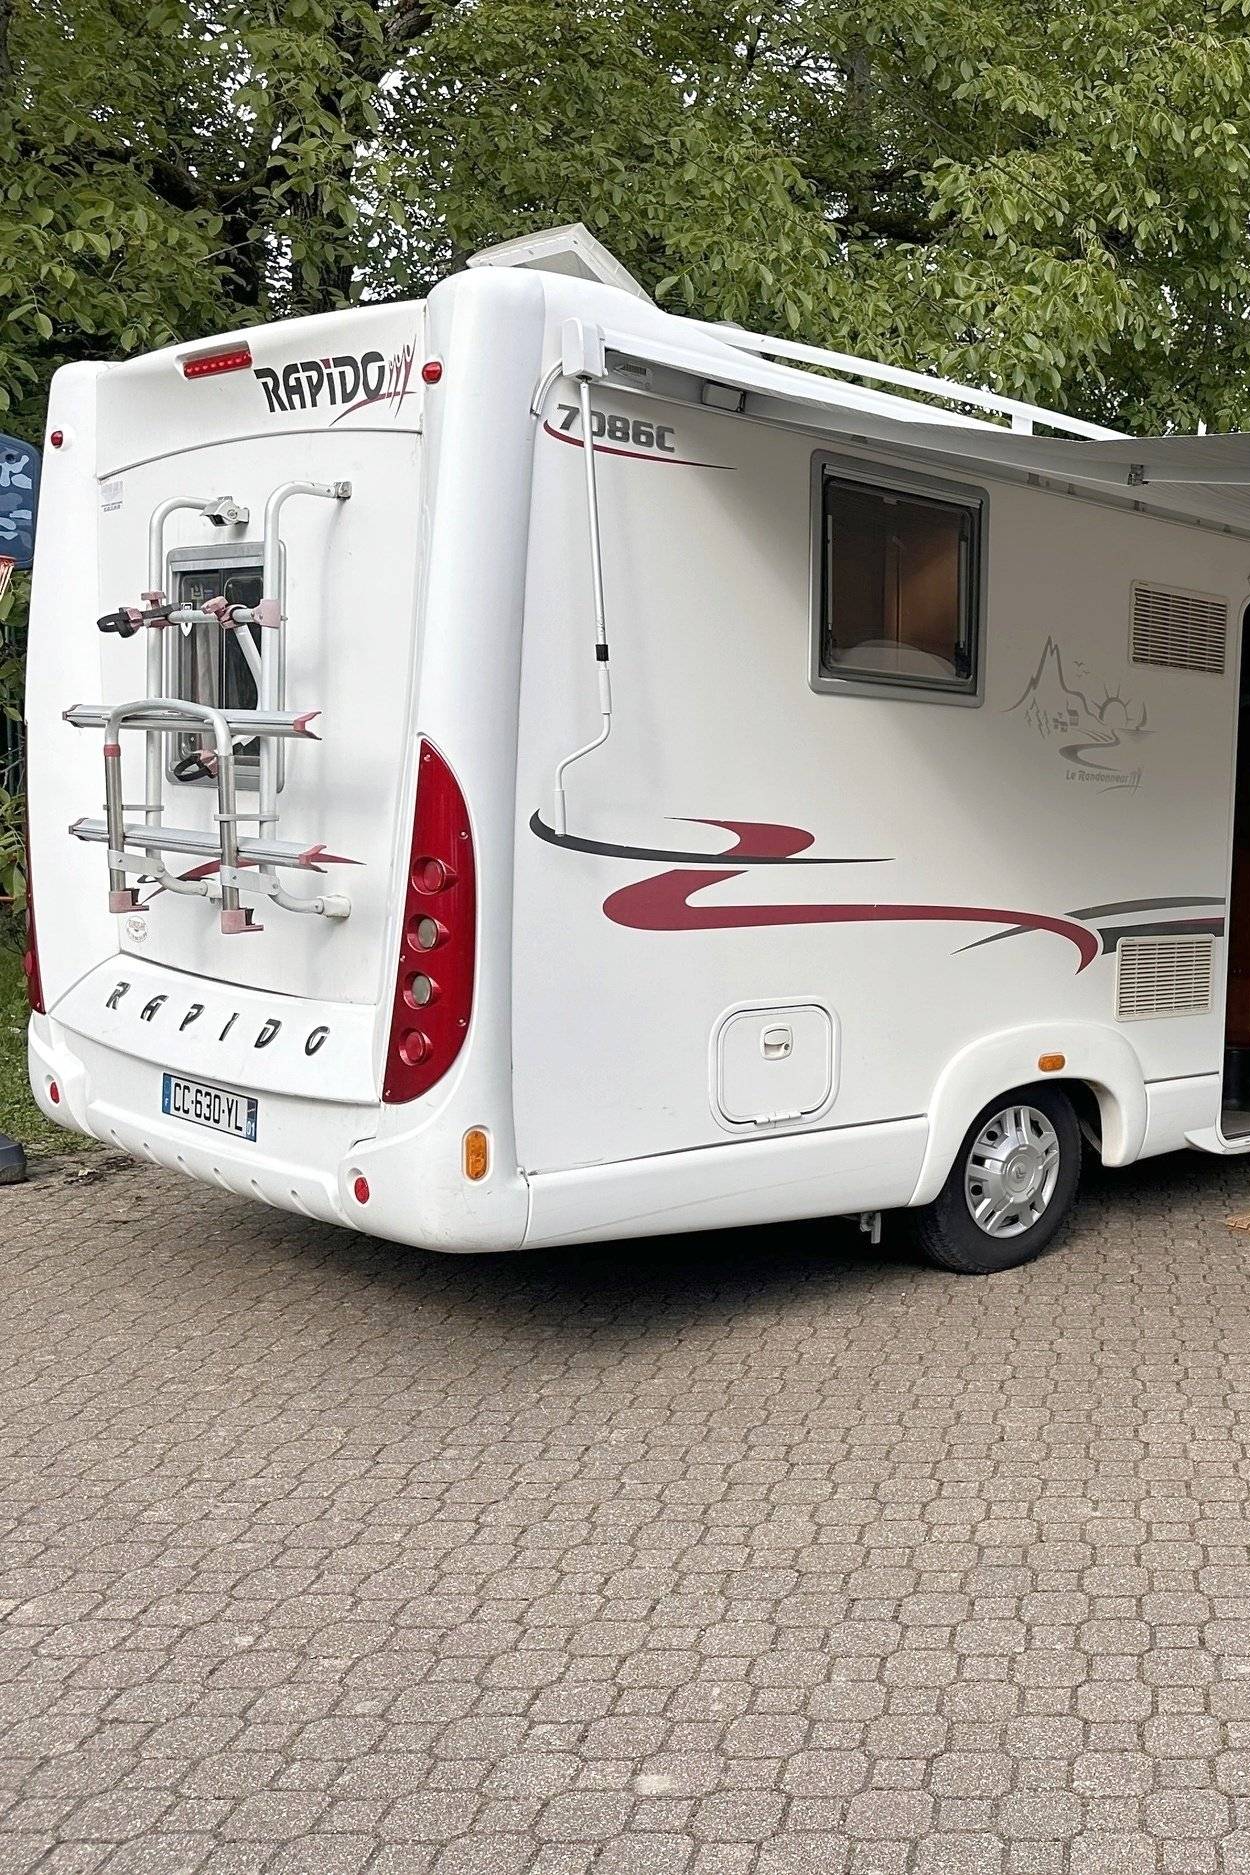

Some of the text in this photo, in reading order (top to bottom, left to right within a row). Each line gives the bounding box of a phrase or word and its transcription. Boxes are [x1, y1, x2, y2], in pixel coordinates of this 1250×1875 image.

[557, 403, 675, 453] 7086C
[1066, 769, 1076, 781] Le
[105, 981, 330, 1056] RAPIDO
